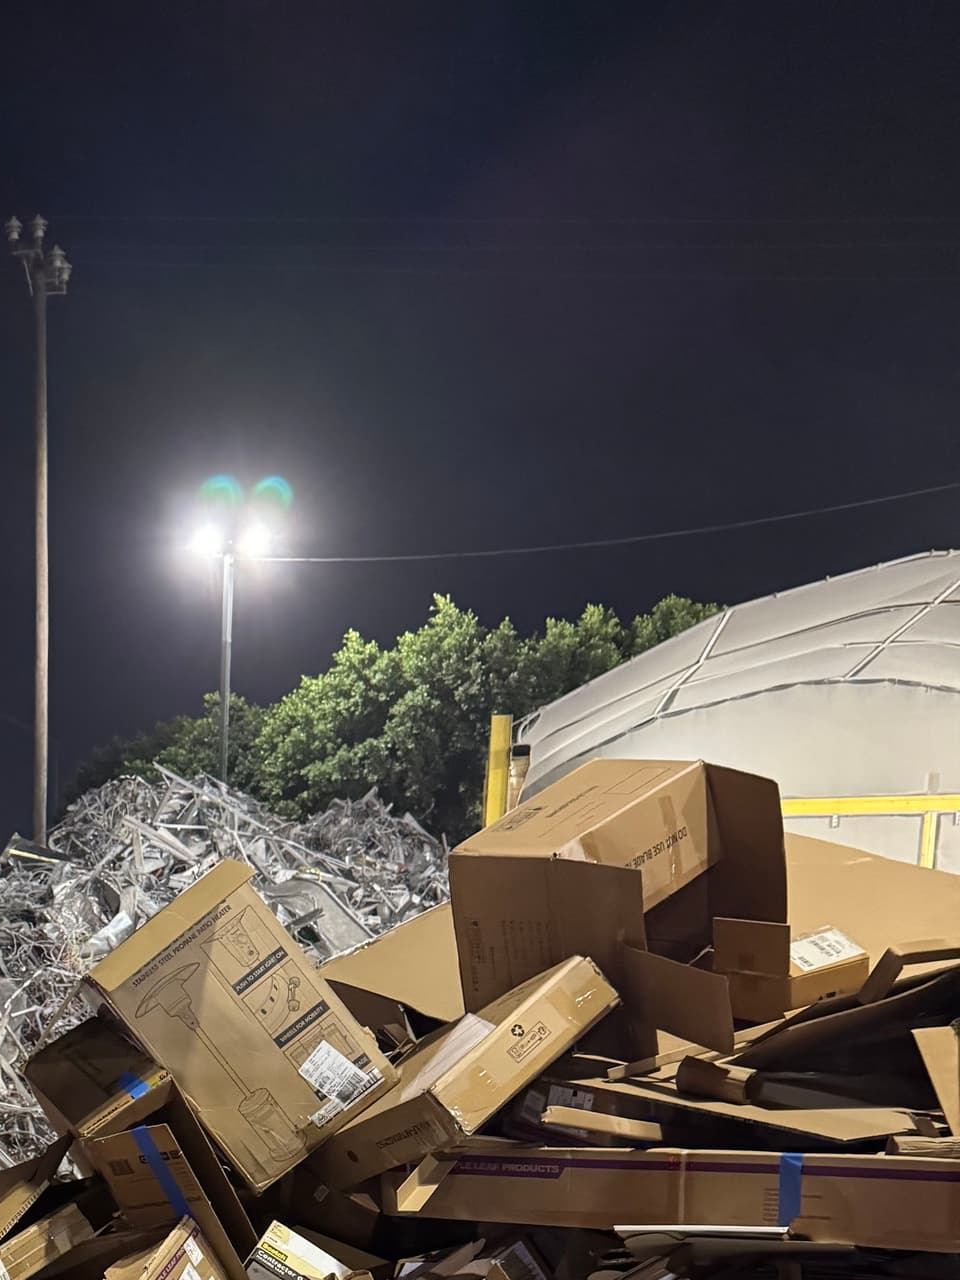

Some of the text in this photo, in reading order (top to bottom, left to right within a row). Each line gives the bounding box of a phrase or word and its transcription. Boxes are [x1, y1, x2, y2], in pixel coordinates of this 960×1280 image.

[212, 905, 233, 924] HEATER
[246, 974, 255, 983] TO
[296, 1019, 307, 1030] FOR
[502, 1163, 560, 1174] PRODUCTS
[262, 1243, 287, 1261] Scotch
[257, 1250, 297, 1278] Contractor
